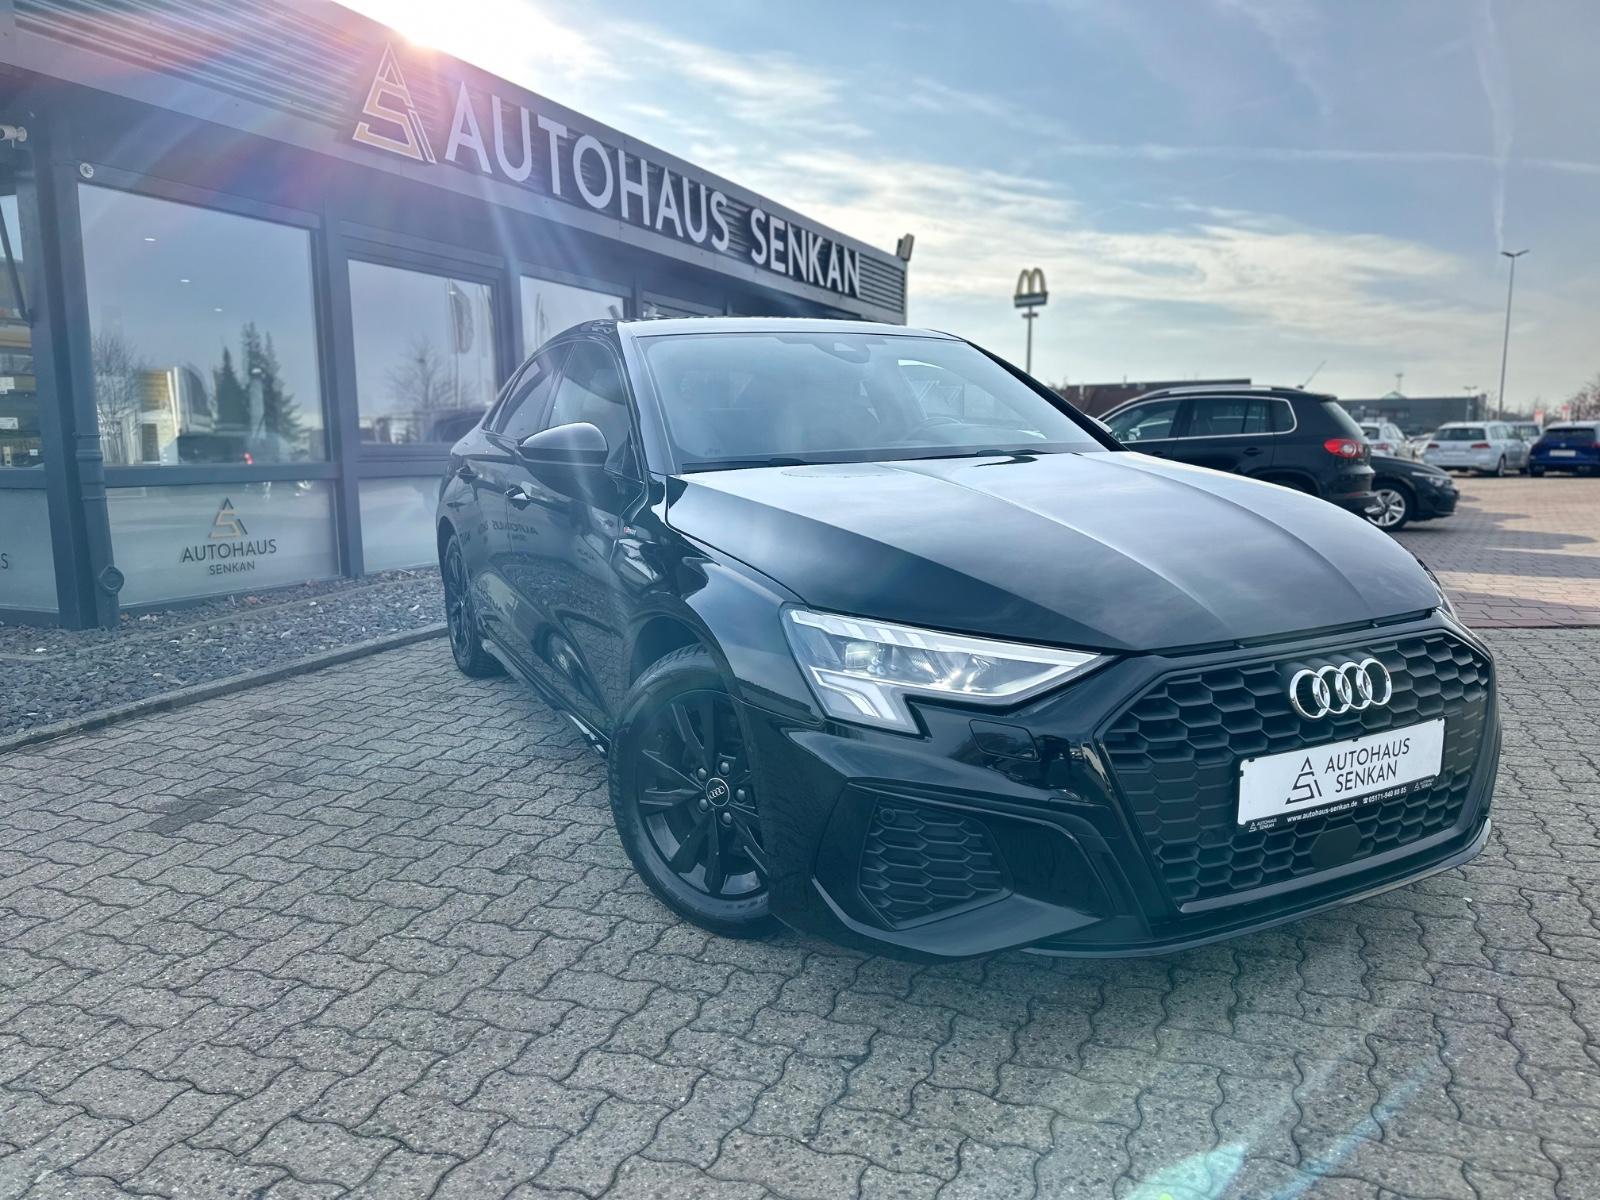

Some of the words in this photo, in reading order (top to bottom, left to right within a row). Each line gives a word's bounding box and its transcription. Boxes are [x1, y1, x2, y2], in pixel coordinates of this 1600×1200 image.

[445, 80, 730, 252] AUTOHAUS
[749, 207, 861, 298] SENKAN
[182, 539, 277, 563] AUTOHAUS
[209, 561, 255, 576] SENKAN
[1324, 737, 1411, 774] AUTOHAUS
[1335, 760, 1398, 793] SENKAN
[1286, 800, 1358, 823] www.autohaus-senkan.de
